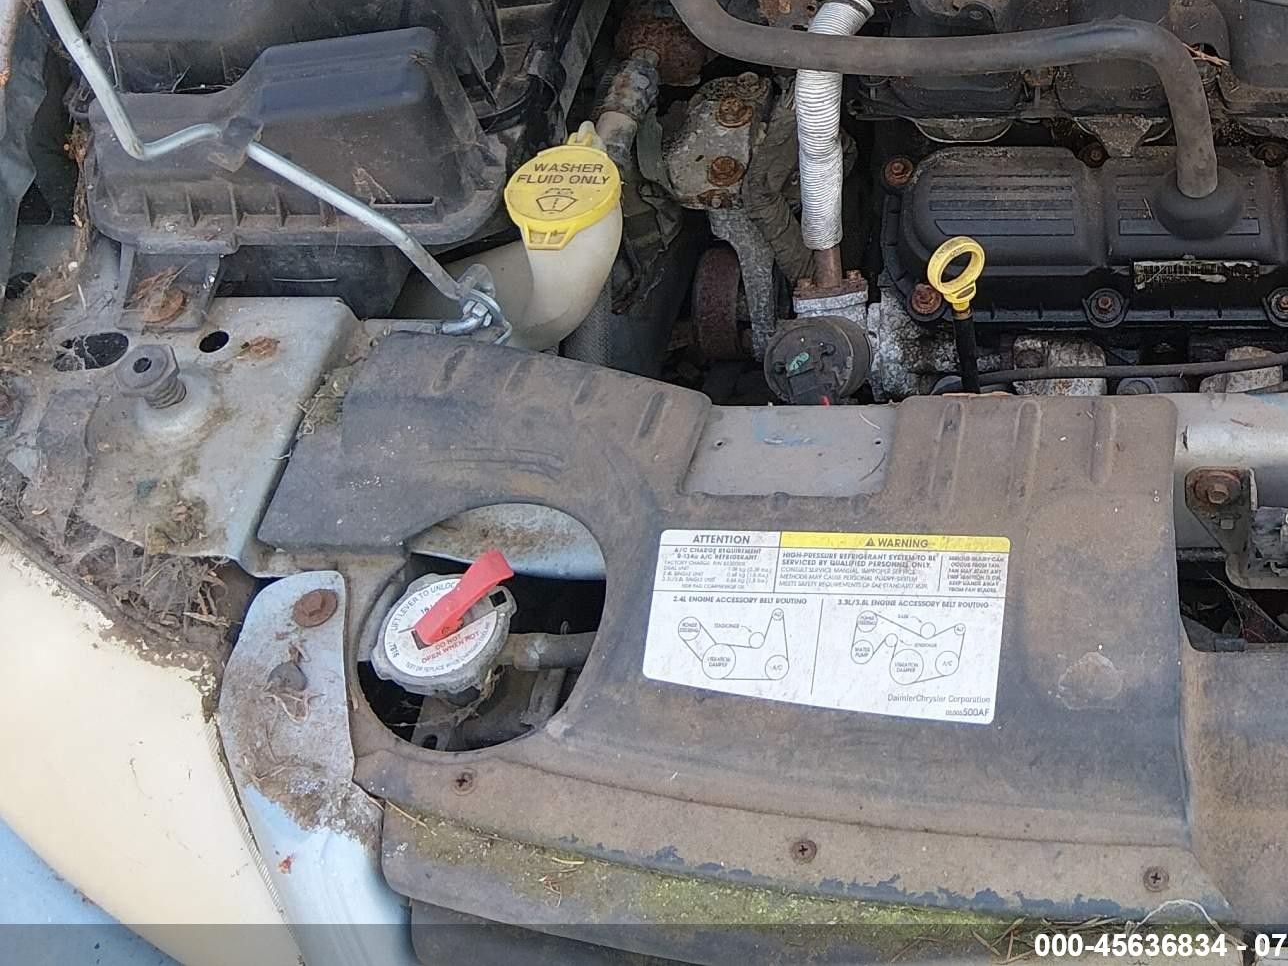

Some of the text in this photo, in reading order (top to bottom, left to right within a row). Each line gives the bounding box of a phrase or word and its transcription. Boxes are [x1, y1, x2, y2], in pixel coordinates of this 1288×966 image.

[535, 163, 604, 173] WASHER
[517, 174, 610, 185] FLUID ONLY
[693, 535, 750, 544] ATTENTION
[878, 538, 929, 548] WARNING
[782, 552, 837, 560] HIGH-PRESSURE
[839, 553, 887, 561] REFRIGERANT
[399, 596, 418, 617] LEVER
[419, 590, 430, 599] TO
[430, 581, 456, 594] UNLOC
[715, 596, 758, 604] ACCESSORY
[422, 650, 442, 664] OPEN
[888, 693, 991, 704] DaimlerChrysler Corporation
